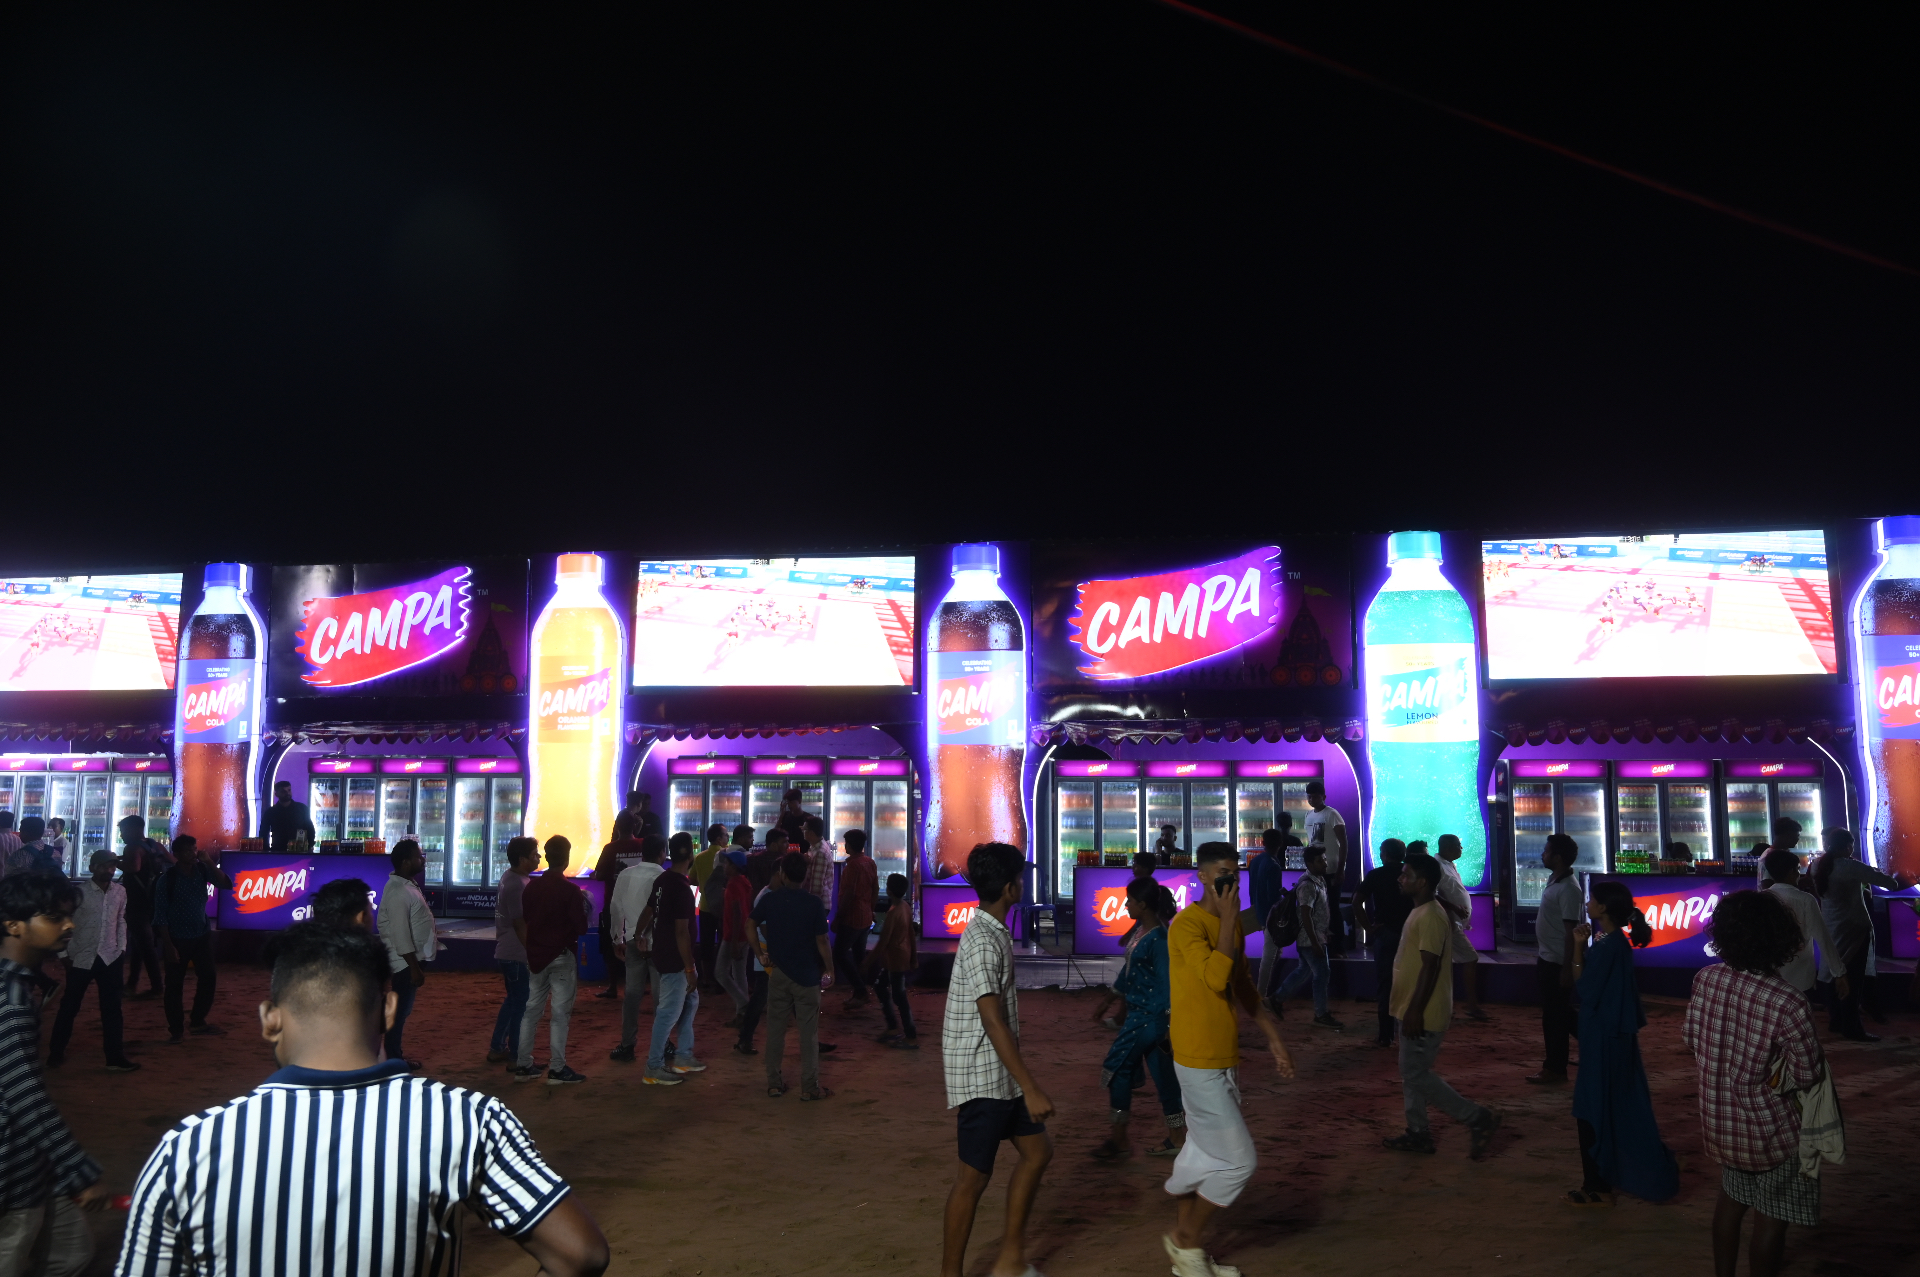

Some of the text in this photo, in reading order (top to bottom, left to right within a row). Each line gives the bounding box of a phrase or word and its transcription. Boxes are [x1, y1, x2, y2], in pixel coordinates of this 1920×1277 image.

[310, 584, 453, 664] CAMPA
[1087, 567, 1261, 653] CAMPA
[184, 680, 246, 719] CAMPA
[540, 678, 608, 717] CAMPA
[966, 718, 989, 726] COLA
[1547, 763, 1569, 774] CAMPA
[1652, 764, 1675, 774] CAMPA
[1761, 763, 1784, 773] CAMPA
[239, 868, 307, 901] CAMPA
[1100, 885, 1187, 921] CAA
[1622, 894, 1719, 933] AMPA
